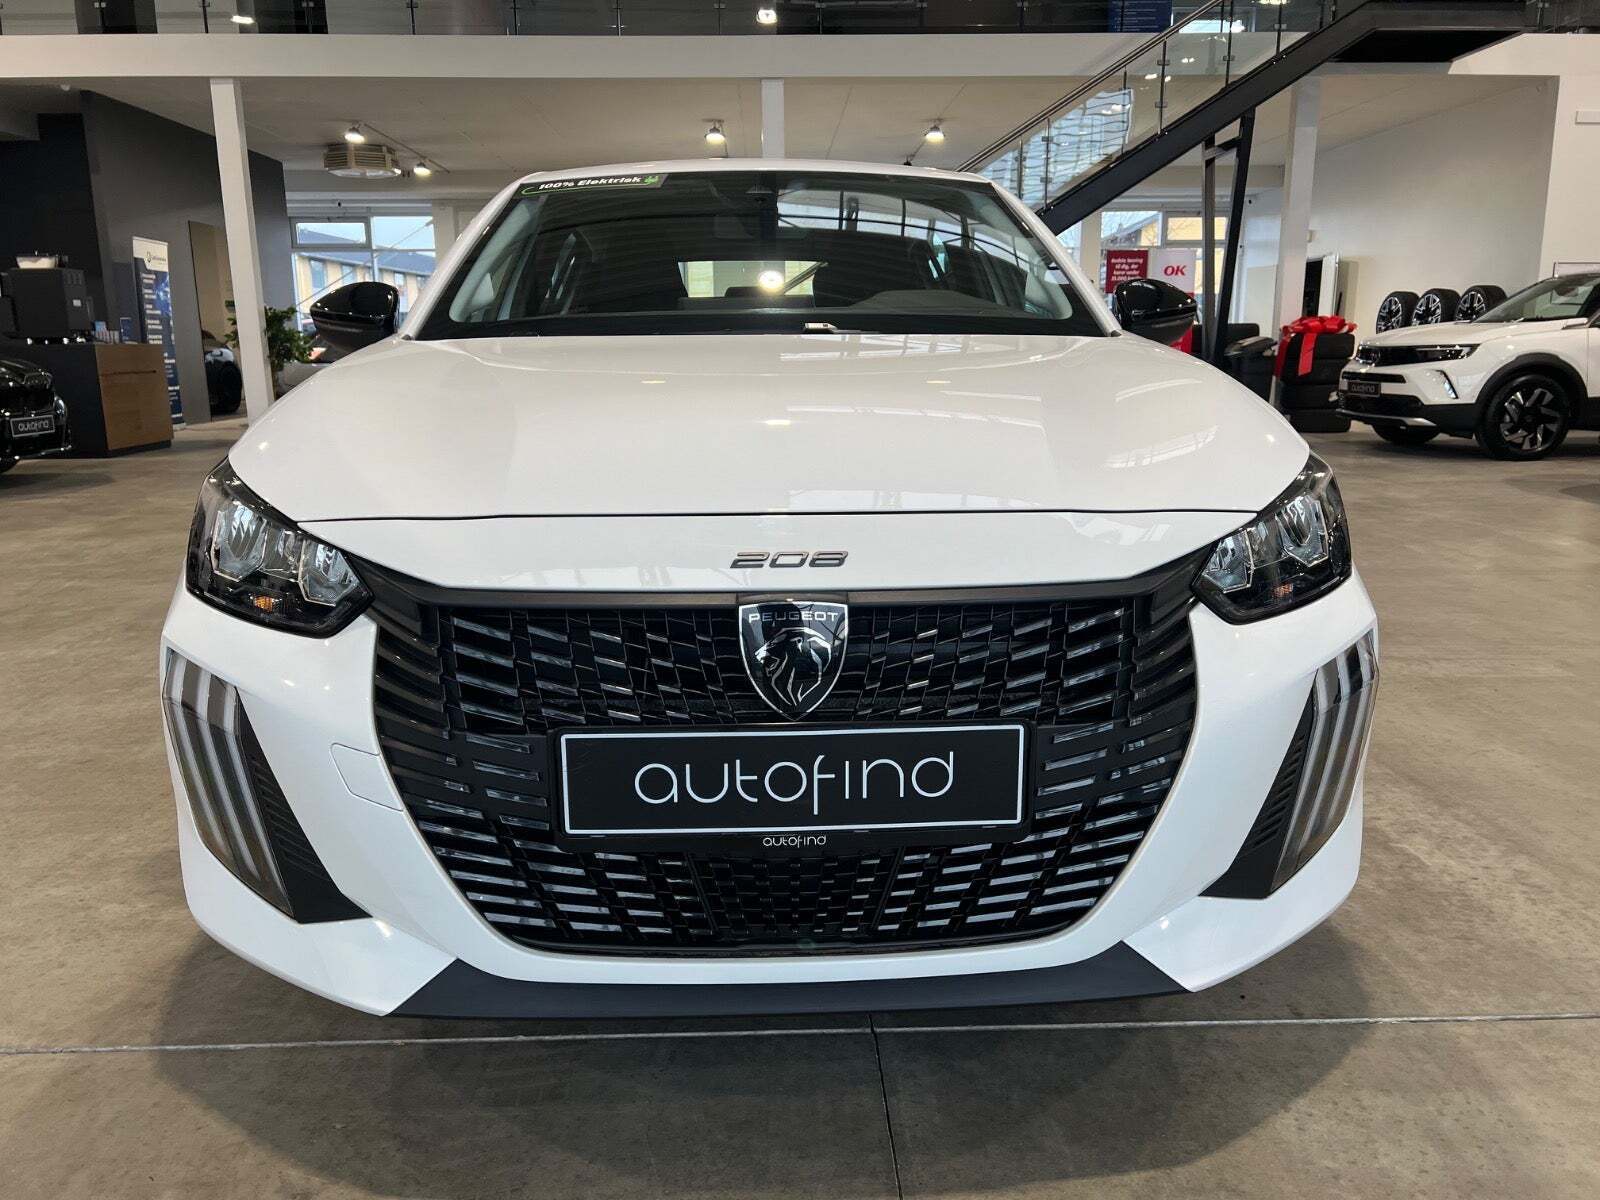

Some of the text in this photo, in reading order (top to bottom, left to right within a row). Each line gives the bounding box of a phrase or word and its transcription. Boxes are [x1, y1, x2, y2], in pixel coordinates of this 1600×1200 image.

[538, 176, 642, 190] 100% Elektrisk
[1163, 265, 1187, 276] OK
[730, 551, 849, 568] 208
[748, 611, 839, 624] PEUGEOT
[634, 751, 955, 816] autofind
[762, 834, 827, 849] autofind
